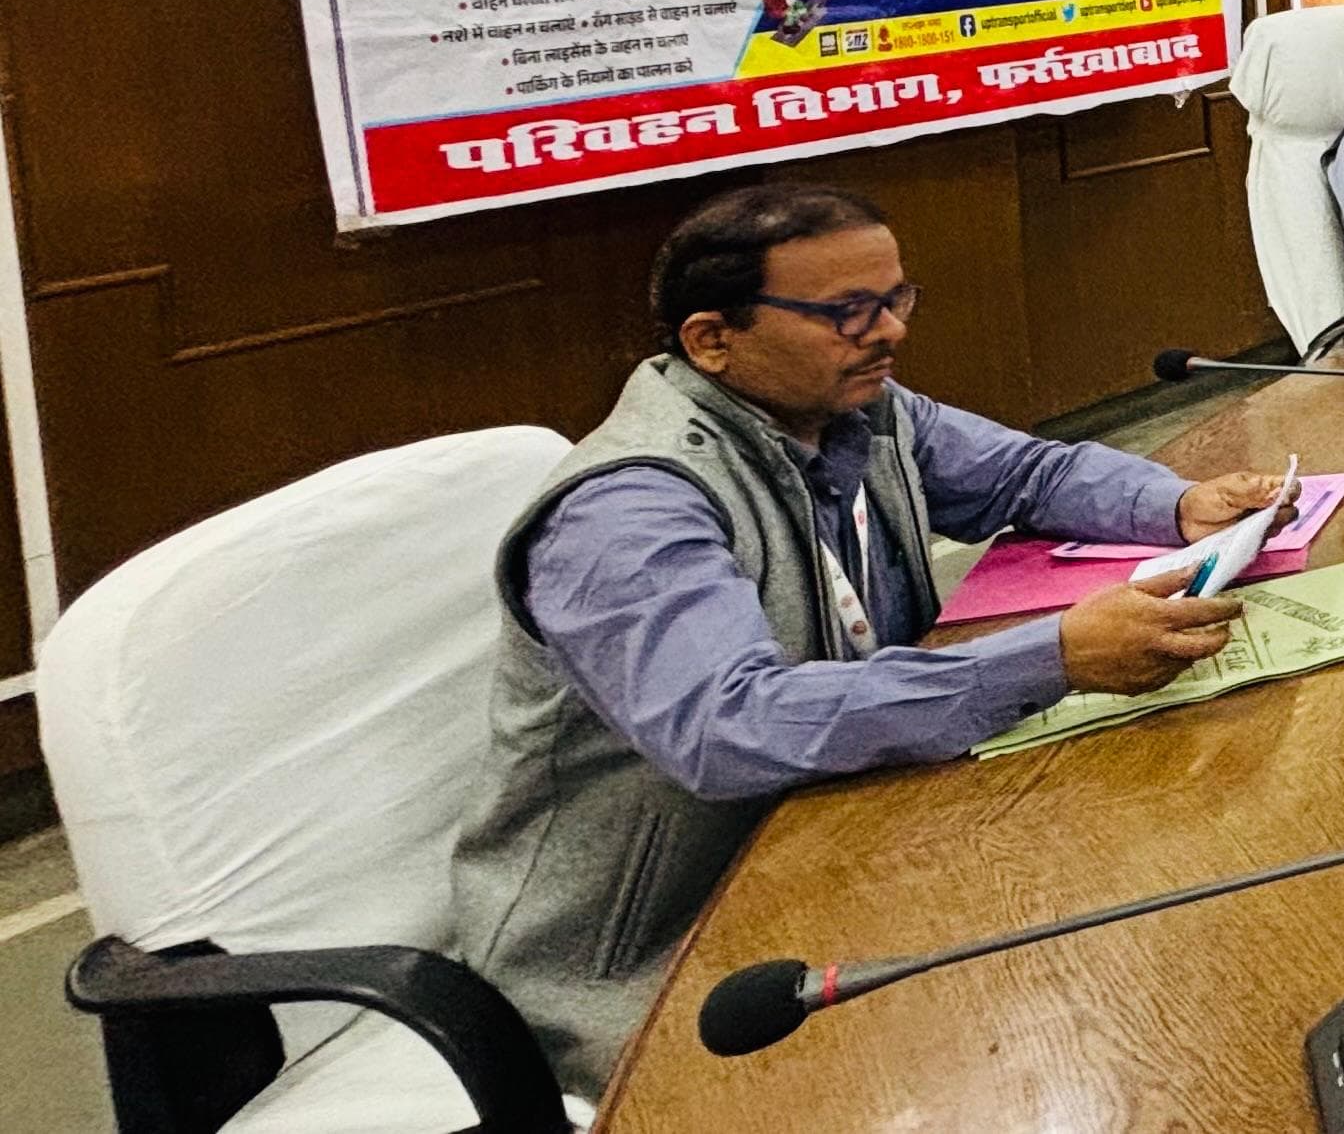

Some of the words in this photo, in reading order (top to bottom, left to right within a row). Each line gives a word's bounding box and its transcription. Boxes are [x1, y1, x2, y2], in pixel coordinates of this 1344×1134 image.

[442, 24, 468, 42] नशे
[471, 23, 484, 40] में
[488, 23, 523, 39] वाहन
[525, 22, 536, 35] न
[646, 5, 658, 21] से
[660, 6, 689, 21] वाहन
[691, 4, 701, 16] न
[512, 48, 541, 66] बिना
[594, 39, 608, 55] के
[611, 38, 641, 53] वाहन
[643, 37, 654, 49] न
[560, 68, 574, 88] के
[617, 67, 634, 80] का
[636, 62, 672, 76] पालन
[438, 104, 741, 173] परिवहन
[753, 73, 963, 128] विभाग,
